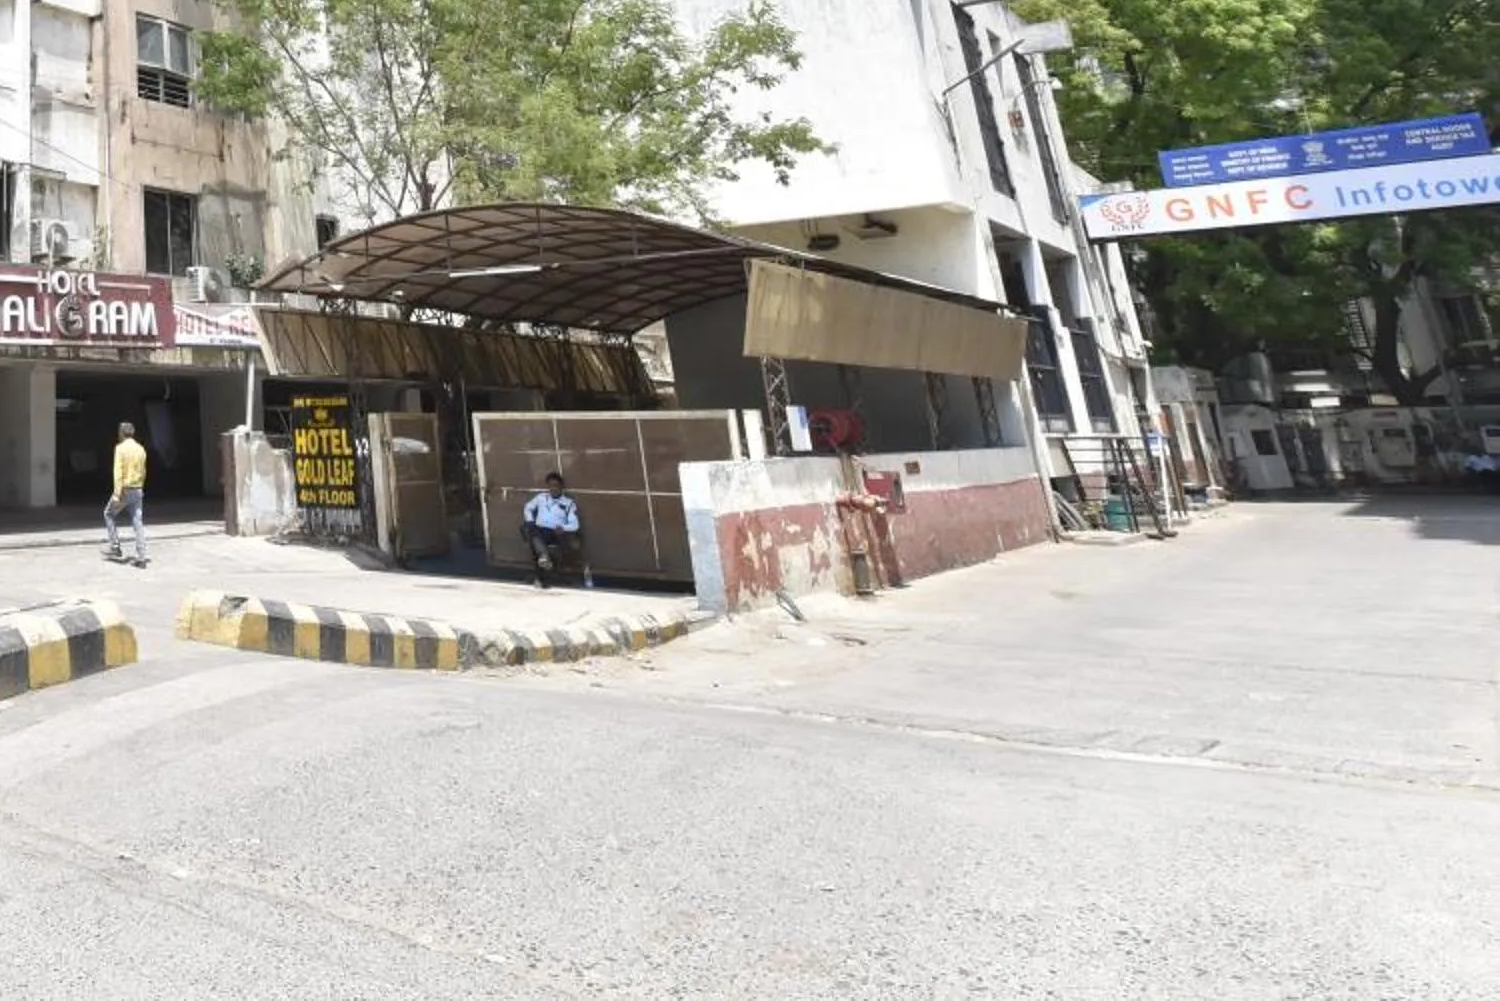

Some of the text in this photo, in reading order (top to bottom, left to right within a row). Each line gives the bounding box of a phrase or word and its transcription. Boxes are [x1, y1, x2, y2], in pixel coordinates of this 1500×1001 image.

[1164, 186, 1314, 223] GNFC
[37, 270, 101, 296] HOTEL
[295, 428, 353, 456] HOTEL
[296, 458, 355, 486] GOLD LEAF
[318, 489, 356, 505] FLOOR
